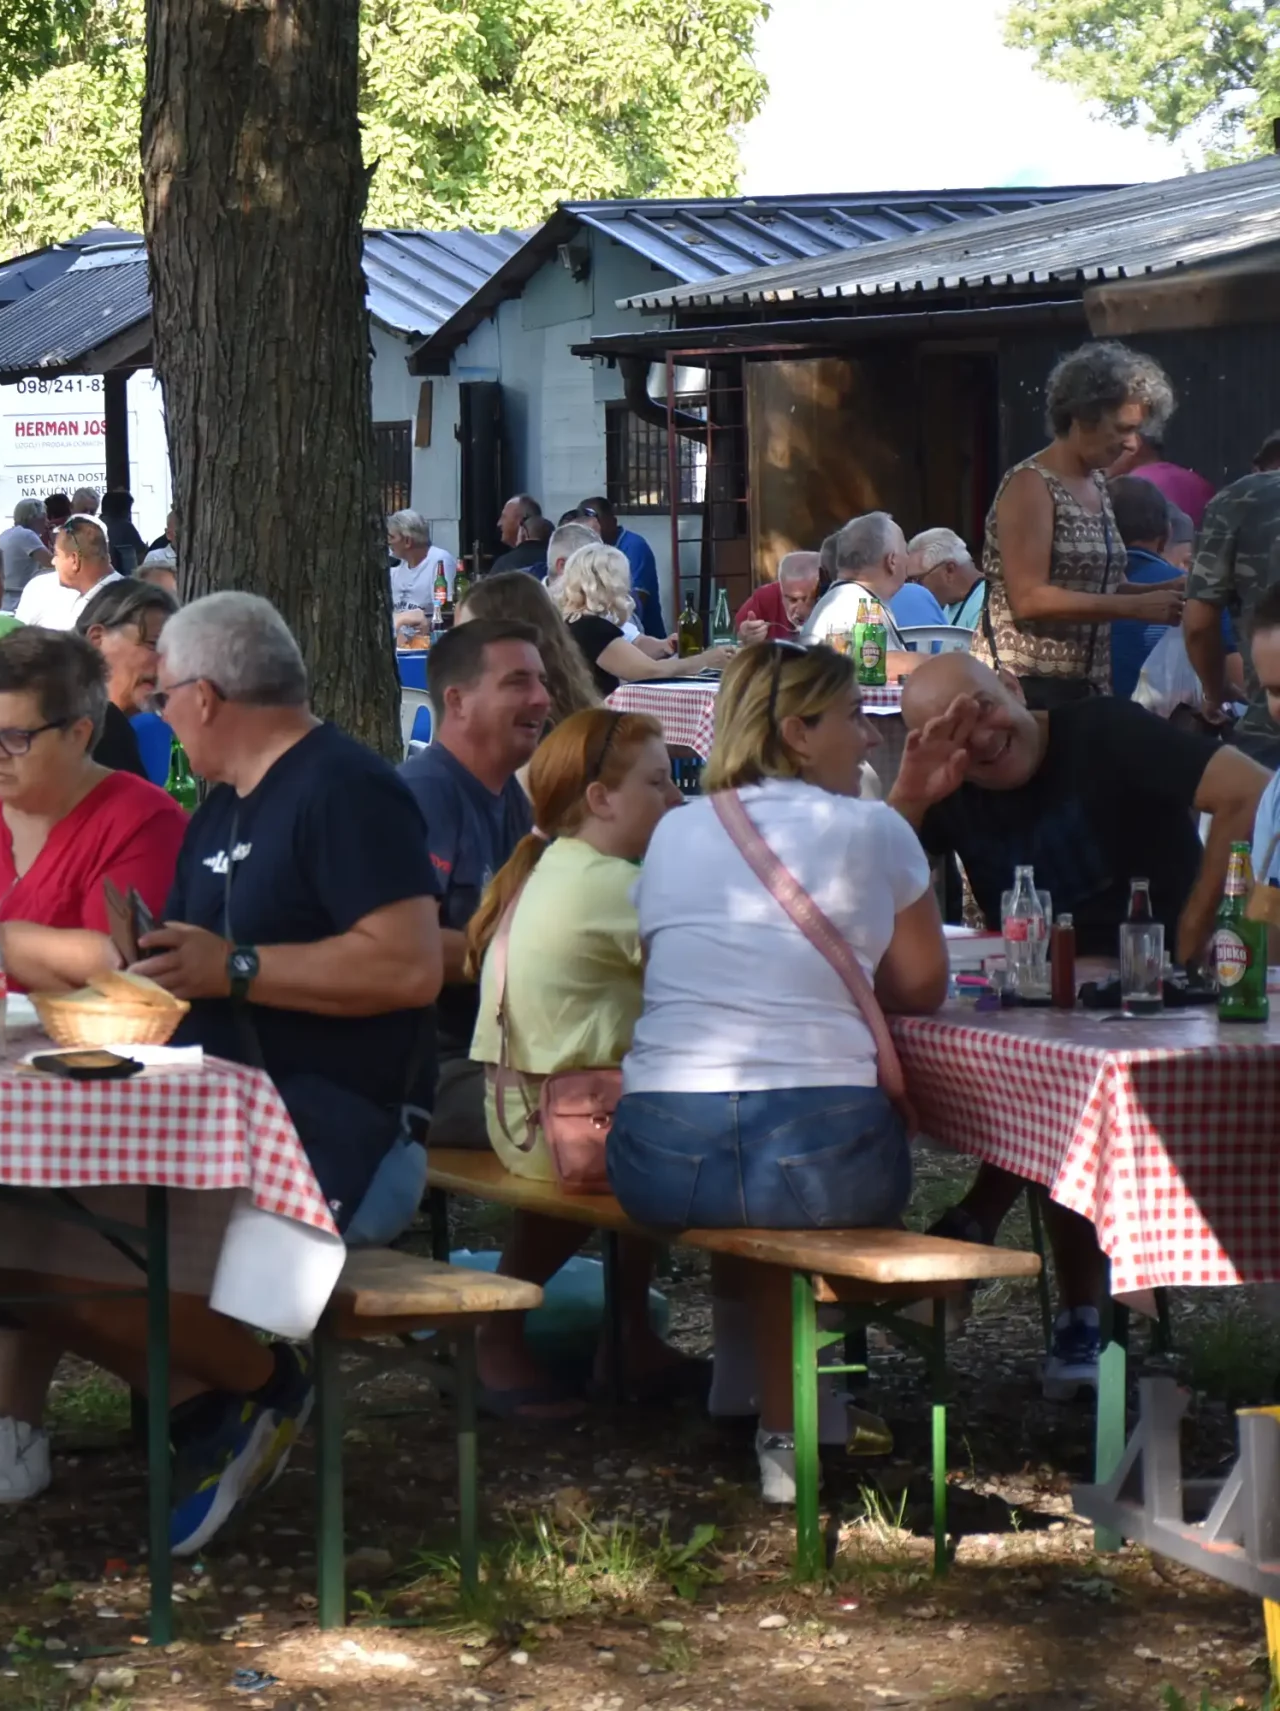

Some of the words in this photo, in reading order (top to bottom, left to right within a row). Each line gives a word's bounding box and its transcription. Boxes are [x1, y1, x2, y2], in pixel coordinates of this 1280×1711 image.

[15, 421, 78, 437] HERMAN
[83, 420, 106, 436] JOS
[17, 473, 75, 484] BESPLATNA
[22, 488, 37, 497] NA
